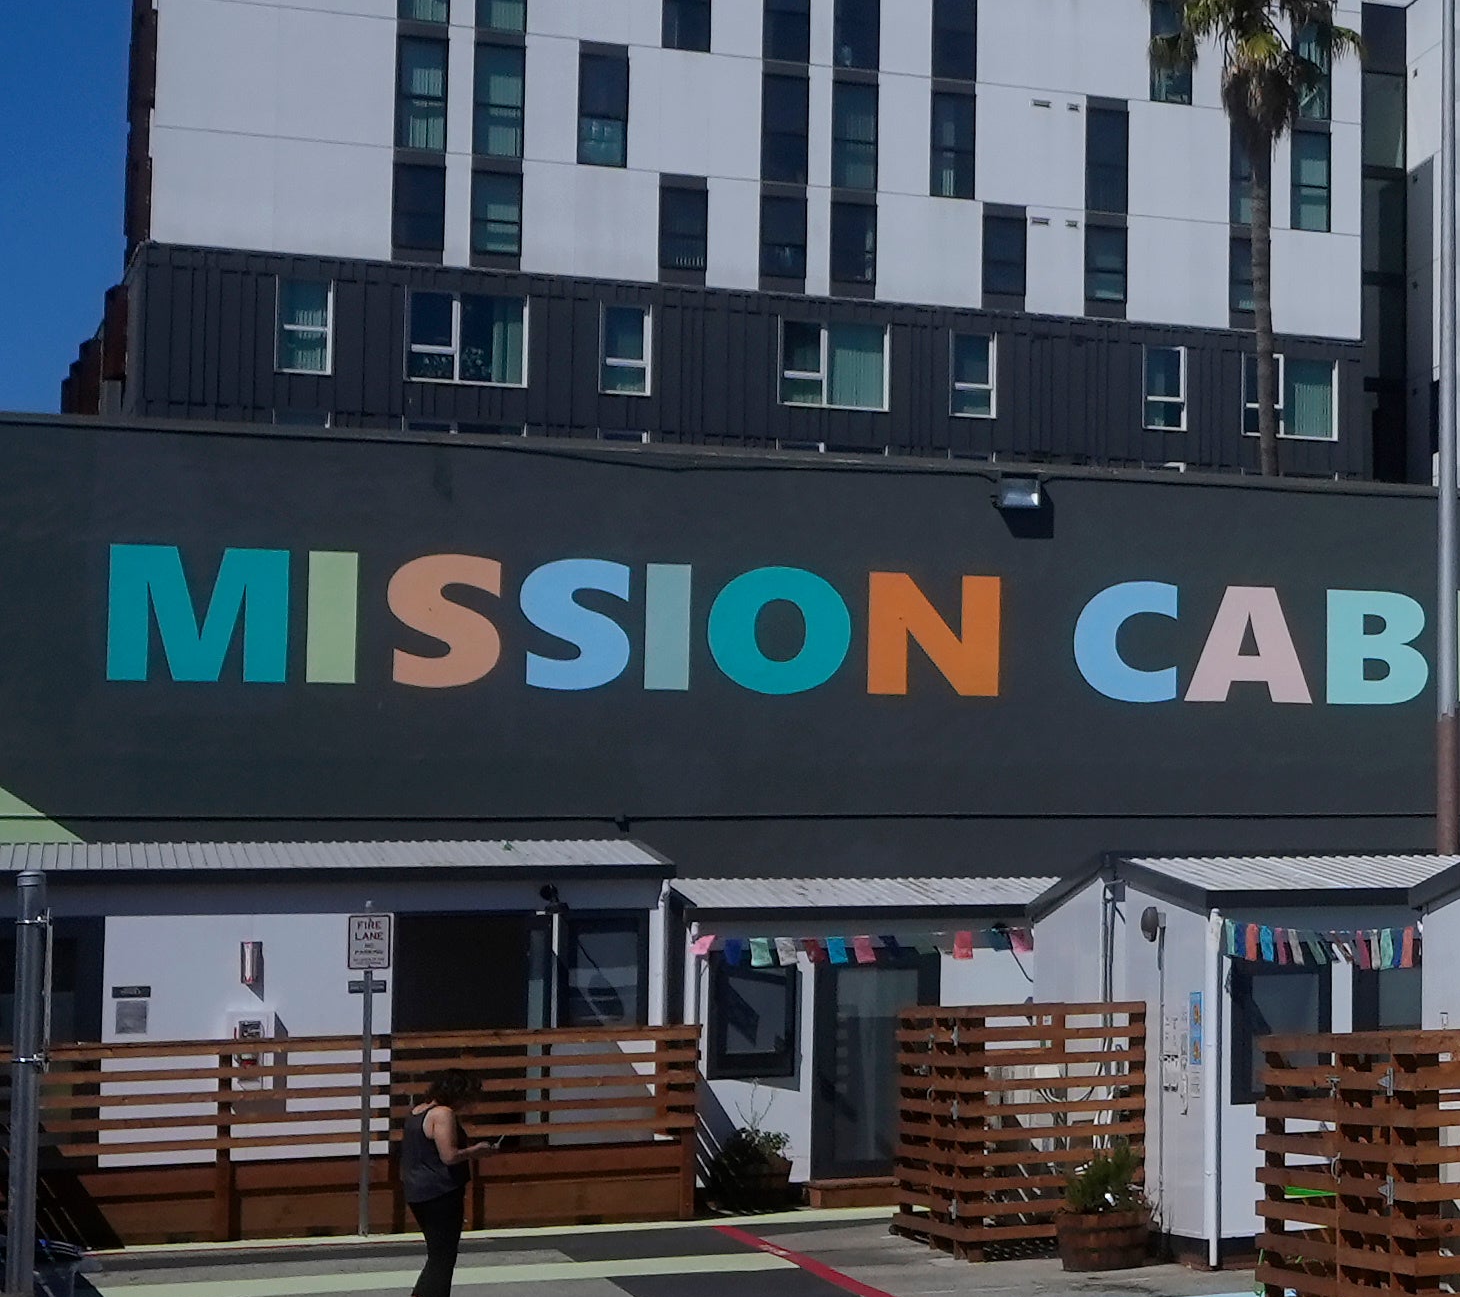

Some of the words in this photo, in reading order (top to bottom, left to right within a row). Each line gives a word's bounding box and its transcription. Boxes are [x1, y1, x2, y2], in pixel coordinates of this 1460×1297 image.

[106, 543, 1001, 698] MISSION
[356, 920, 382, 930] FIRE
[354, 931, 384, 941] LANE
